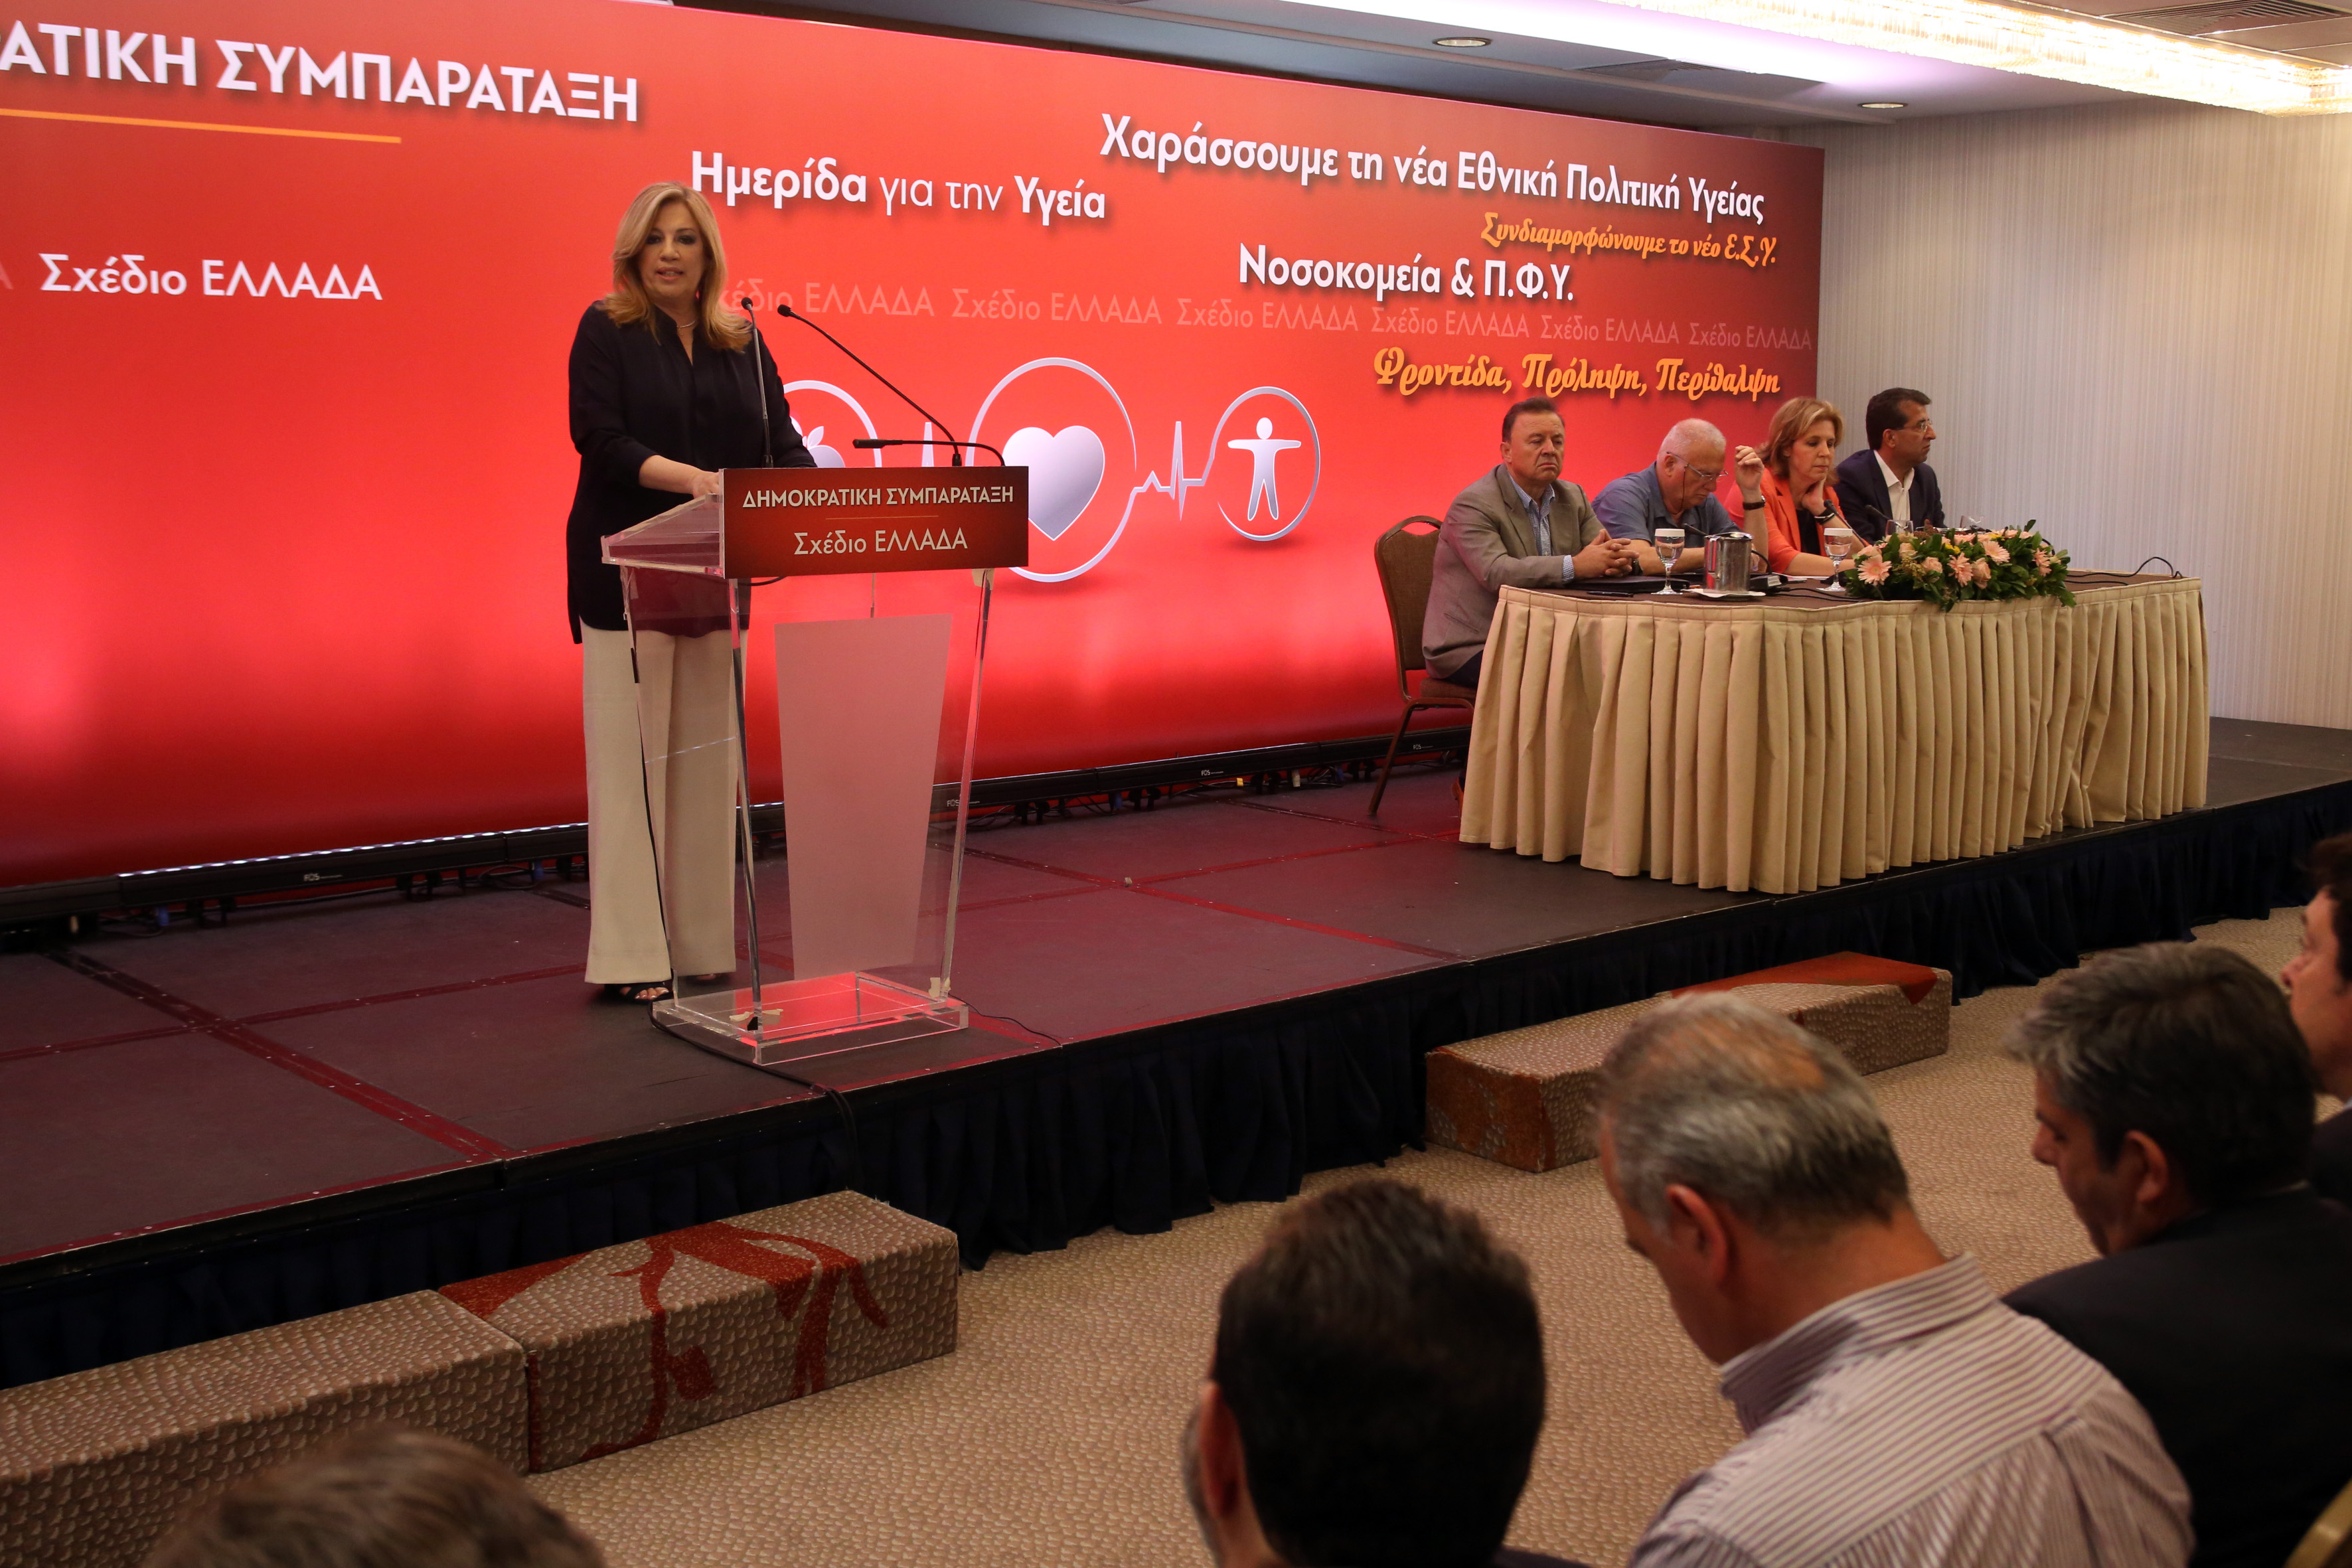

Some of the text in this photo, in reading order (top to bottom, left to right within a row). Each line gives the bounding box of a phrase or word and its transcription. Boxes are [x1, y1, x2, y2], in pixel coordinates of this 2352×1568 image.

[215, 39, 637, 122] ΣΥΜΠΑΡΑΤΑΞΗ
[692, 150, 1105, 226] Ημερίδα για την Υγεία
[1099, 113, 1764, 225] Χαράσσουμε τη νέα Εθνική Πολιτική Υγείας
[1480, 212, 1666, 260] Συνδιαμορφώνουμε
[1668, 238, 1689, 255] το
[1693, 234, 1721, 258] νέο
[39, 253, 187, 295] Σχέδιο
[202, 259, 382, 301] ΕΛΛΑΔΑ
[1239, 242, 1573, 302] Νοσοκομεία & Π.Φ.Υ.
[806, 282, 935, 317] ΕΛΛΑΔΑ
[951, 288, 1040, 321] Σχέδιο
[1051, 292, 1162, 325] ΕΛΛΑΔΑ
[1176, 298, 1253, 328] Σχέδιο
[1262, 301, 1358, 331] ΕΛΛΑΔΑ
[1371, 306, 1438, 335] Σχέδιο
[1445, 310, 1529, 338] ΕΛΛΑΔΑ
[1540, 314, 1599, 341] Σχέδιο
[1605, 318, 1680, 344] ΕΛΛΑΔΑ
[1688, 322, 1741, 347] Σχέδιο
[1746, 325, 1812, 350] ΕΛΛΑΔΑ
[1373, 347, 1780, 401] Φροντίδα, Πρόληψη, Περίθαλψη
[742, 486, 1013, 508] ΔΗΜΟΚΡΑΤΙΚΗ ΣΥΜΠΑΡΑΤΑΞΗ
[794, 527, 968, 555] Σχέδιο ΕΛΛΑΔΑ
